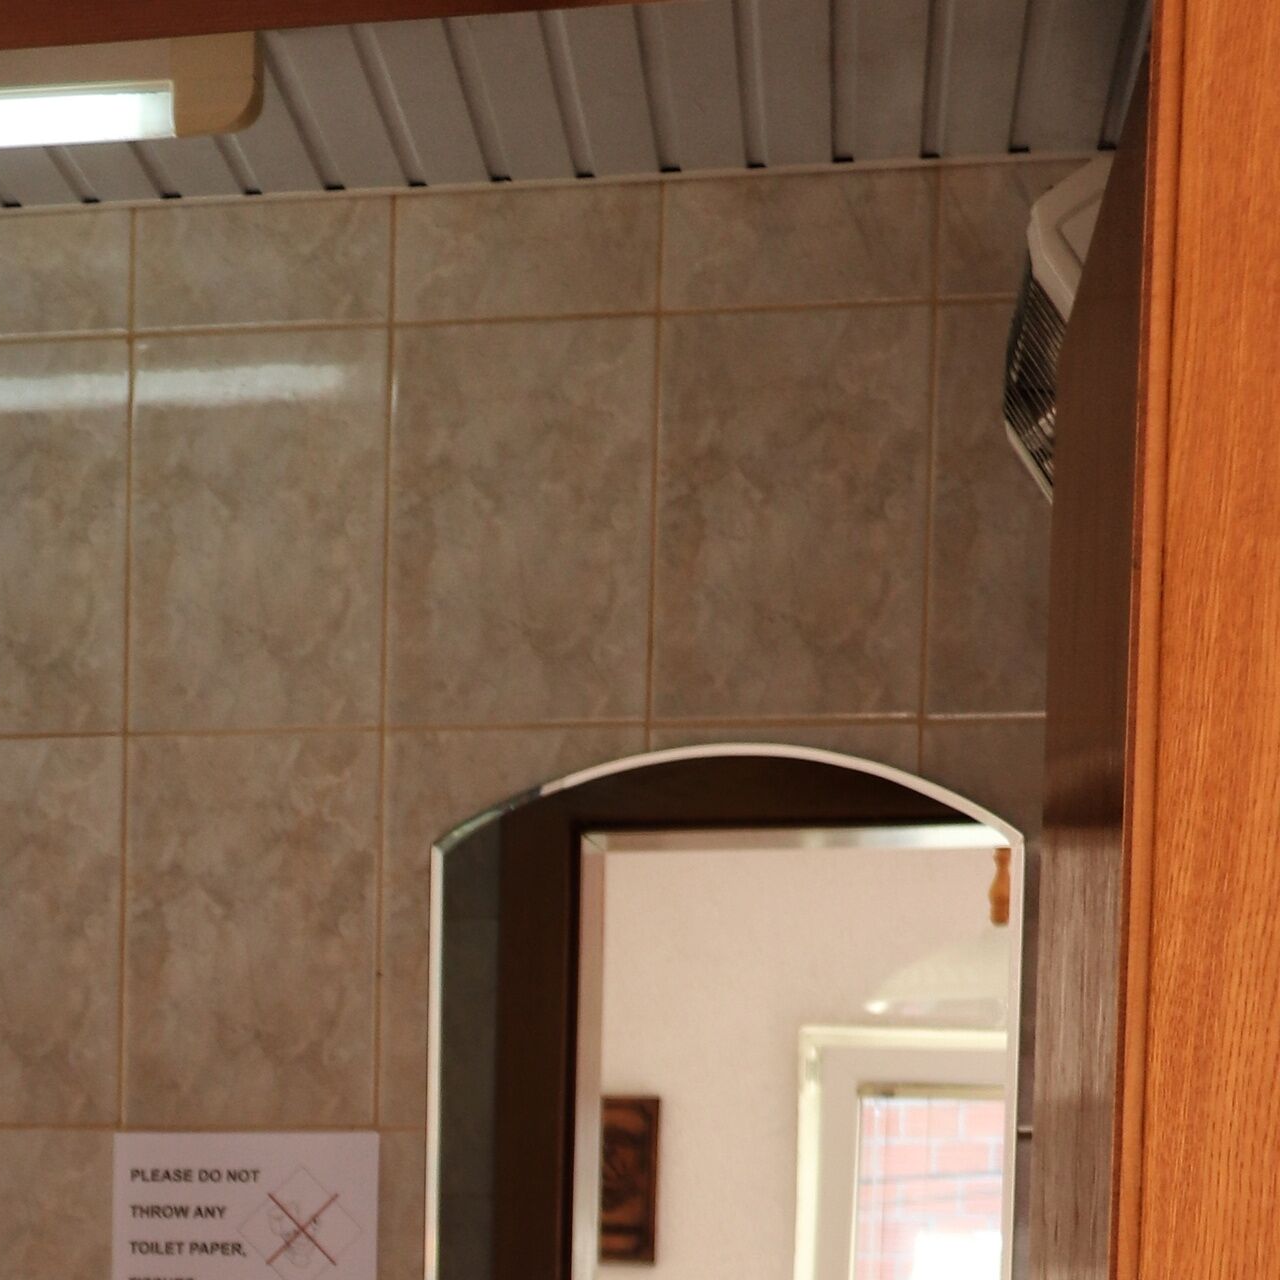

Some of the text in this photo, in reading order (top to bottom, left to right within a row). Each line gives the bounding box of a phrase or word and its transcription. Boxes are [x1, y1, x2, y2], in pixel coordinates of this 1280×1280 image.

[130, 1168, 261, 1183] PLEASE DO NOT
[130, 1205, 226, 1219] THROW ANY
[129, 1241, 184, 1255] TOILET
